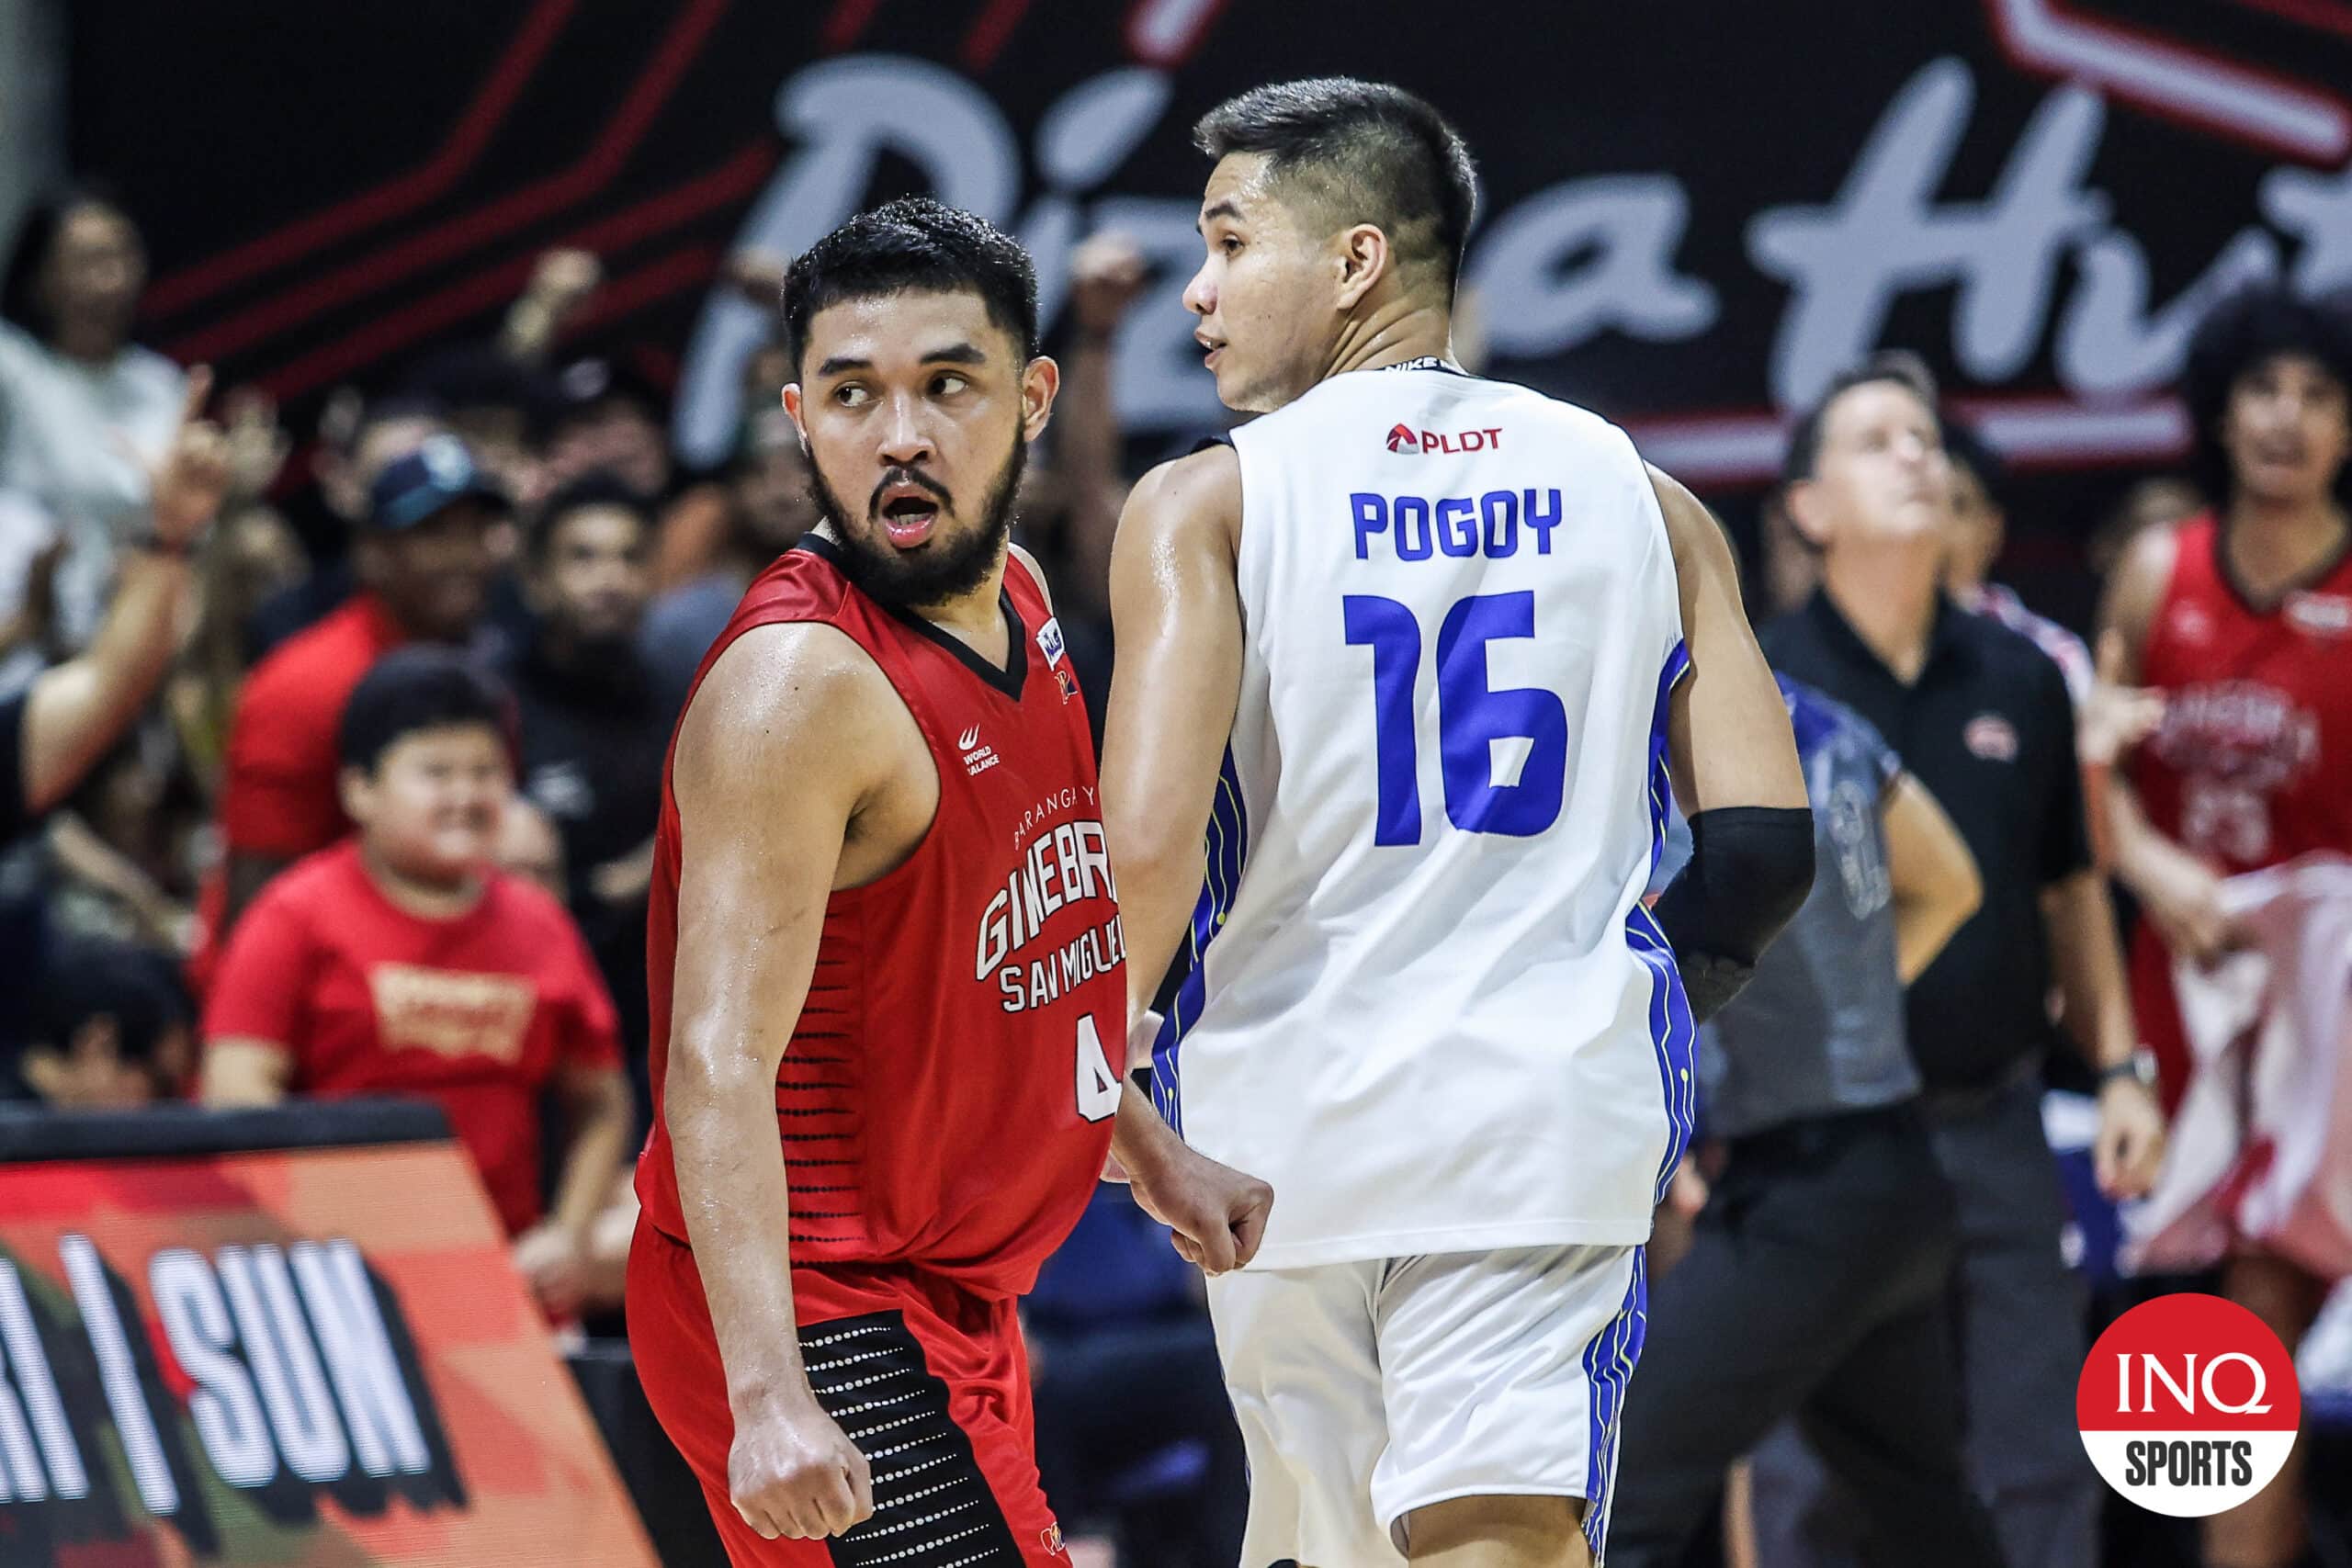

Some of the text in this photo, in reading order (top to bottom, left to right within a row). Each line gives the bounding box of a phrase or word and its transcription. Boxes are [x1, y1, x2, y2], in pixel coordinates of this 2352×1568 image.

[673, 53, 1718, 466] Piza
[1384, 355, 1436, 374] NIKE
[1420, 428, 1503, 455] PLDT
[1349, 488, 1563, 561] POGOY
[963, 745, 992, 765] WORLD
[967, 753, 1001, 776] ALANCE
[1342, 589, 1568, 846] 16
[975, 819, 1119, 982] GINEBR
[1000, 913, 1127, 1012] SAN MIGUEL
[1075, 1012, 1124, 1122] 4
[147, 1235, 434, 1489] SUN
